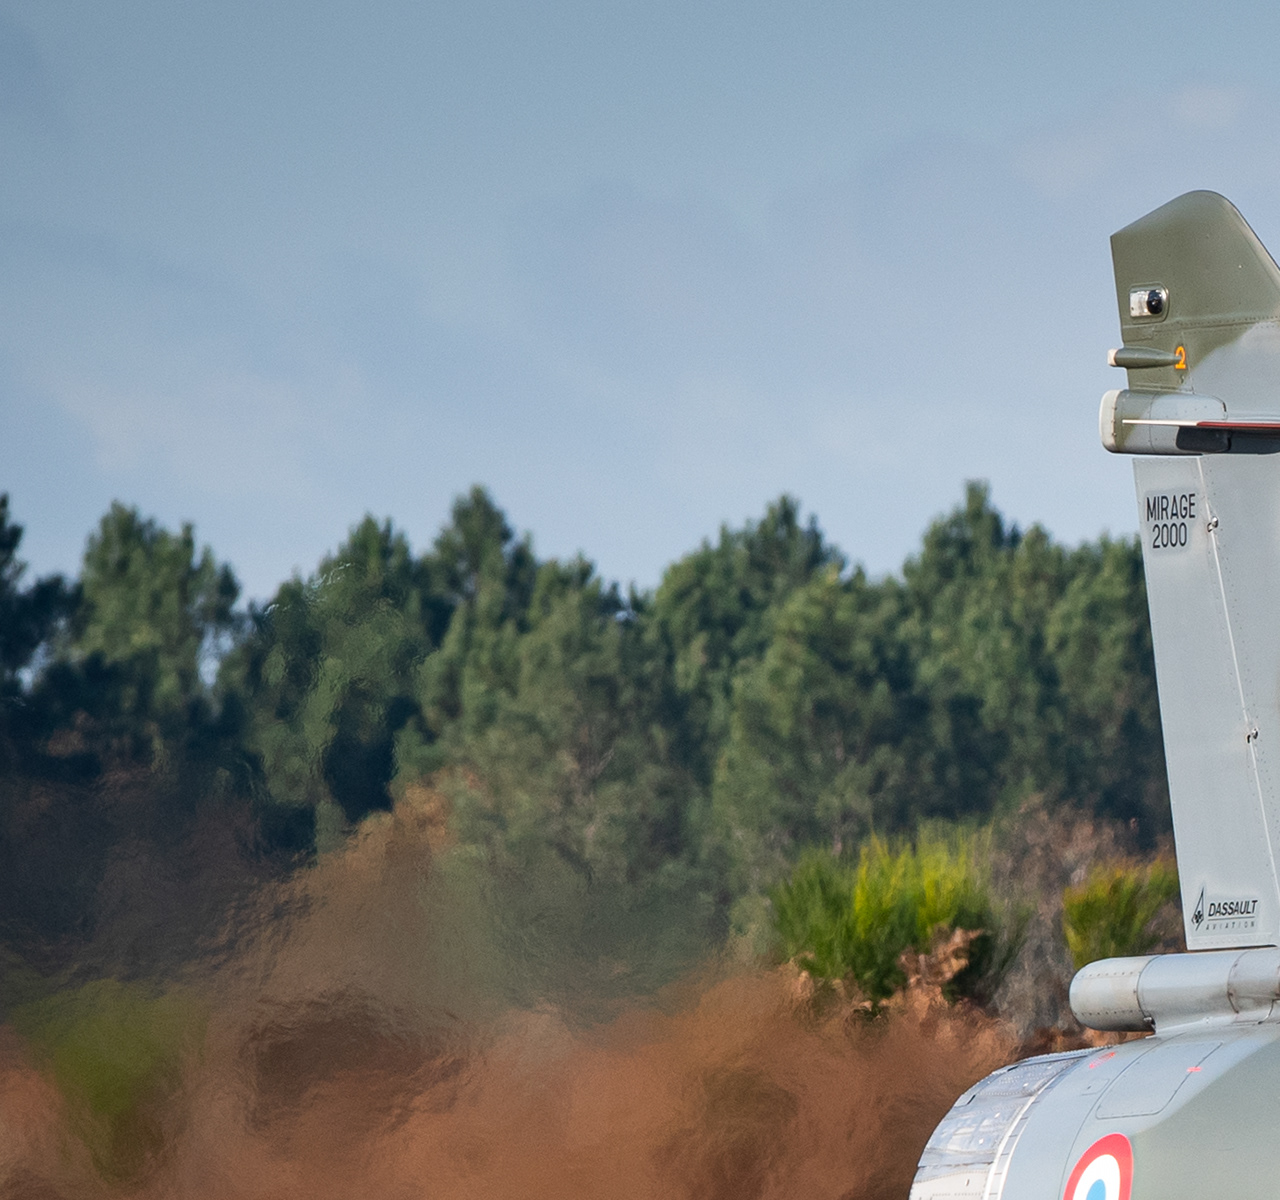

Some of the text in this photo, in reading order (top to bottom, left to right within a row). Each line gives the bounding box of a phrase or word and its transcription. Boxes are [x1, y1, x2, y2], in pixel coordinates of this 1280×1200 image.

[1175, 346, 1186, 369] 2
[1146, 493, 1196, 522] MIRAGE
[1152, 522, 1188, 549] 2000
[1208, 899, 1258, 917] DASSAULT
[1206, 921, 1255, 931] AVIATION
